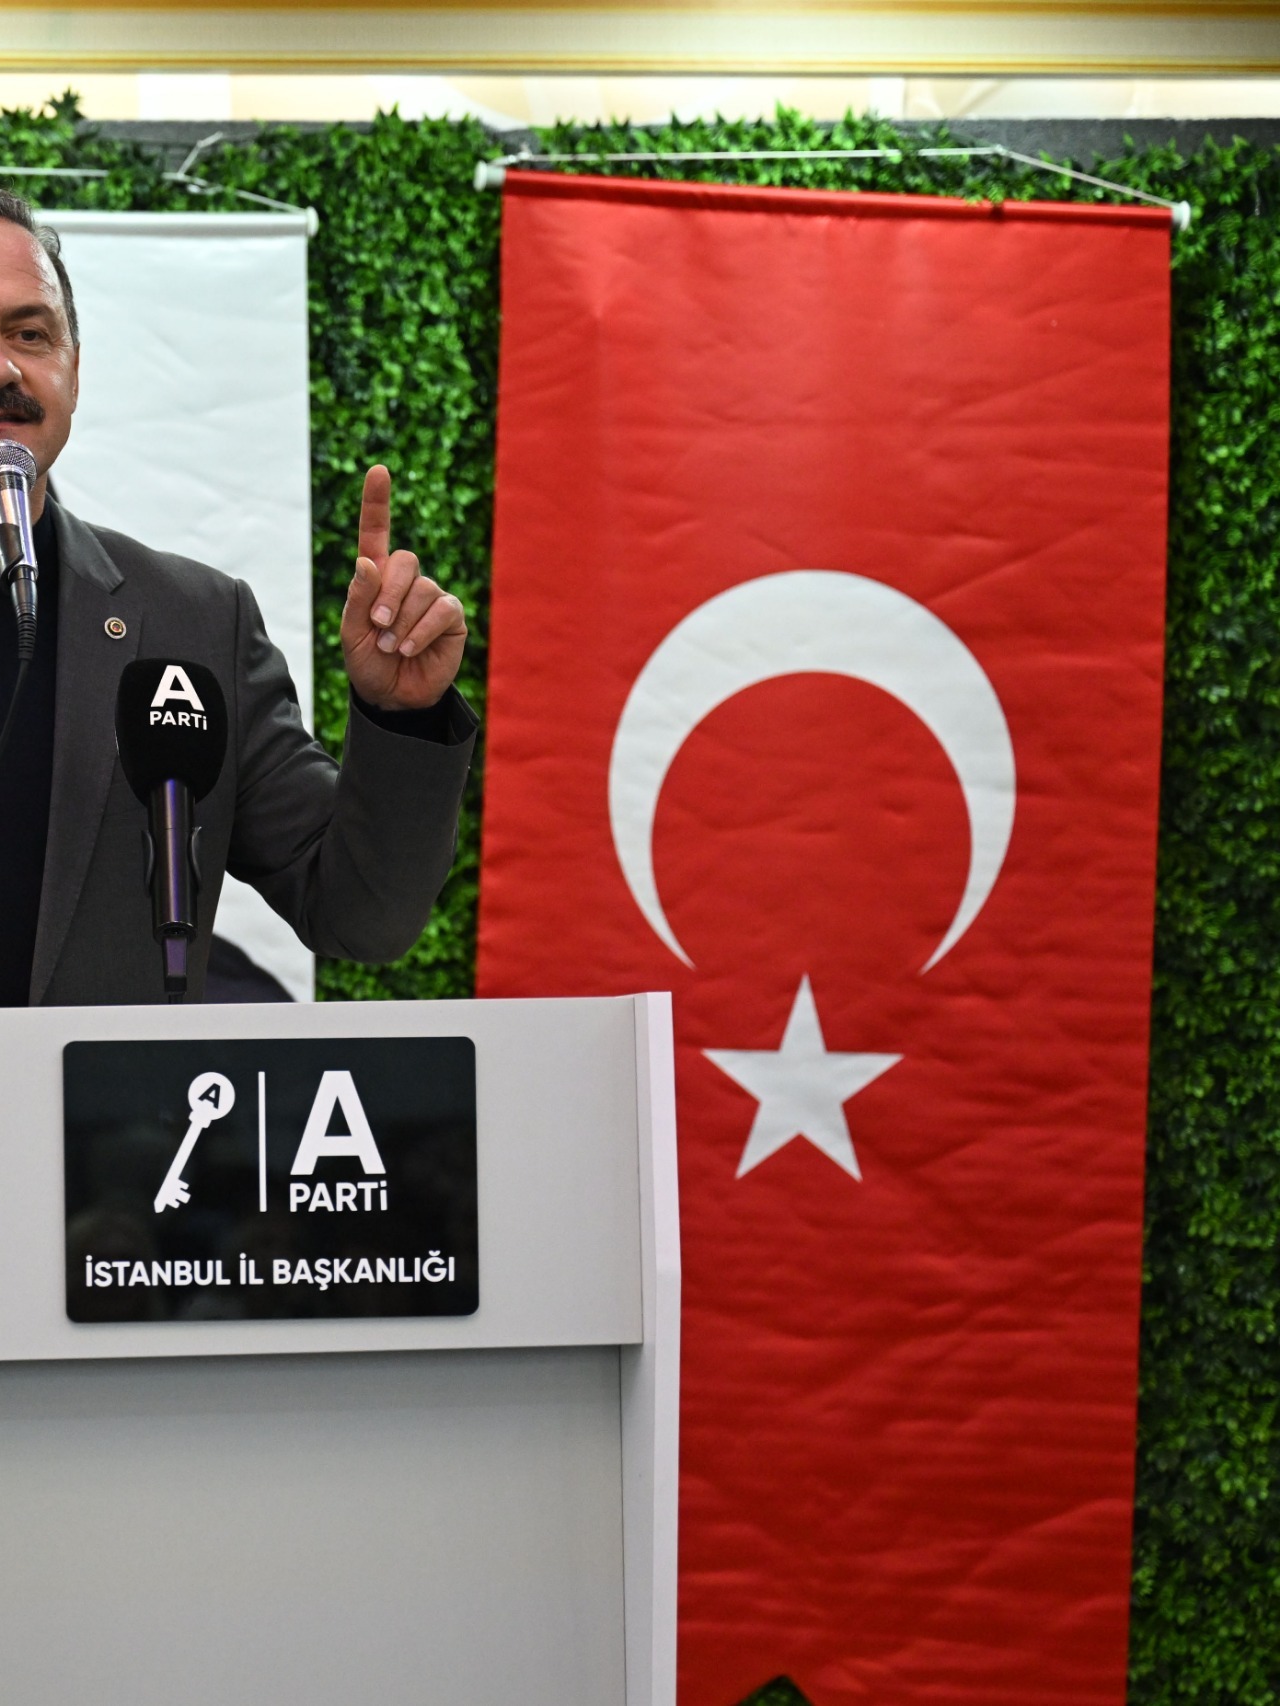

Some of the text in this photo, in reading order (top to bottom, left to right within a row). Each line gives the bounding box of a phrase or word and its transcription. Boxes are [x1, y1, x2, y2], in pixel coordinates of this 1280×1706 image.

[150, 664, 205, 712] A
[198, 1082, 222, 1109] A
[291, 1070, 387, 1176] A
[85, 1250, 455, 1291] İSTANBUL İL BAŞKANLIĞI
